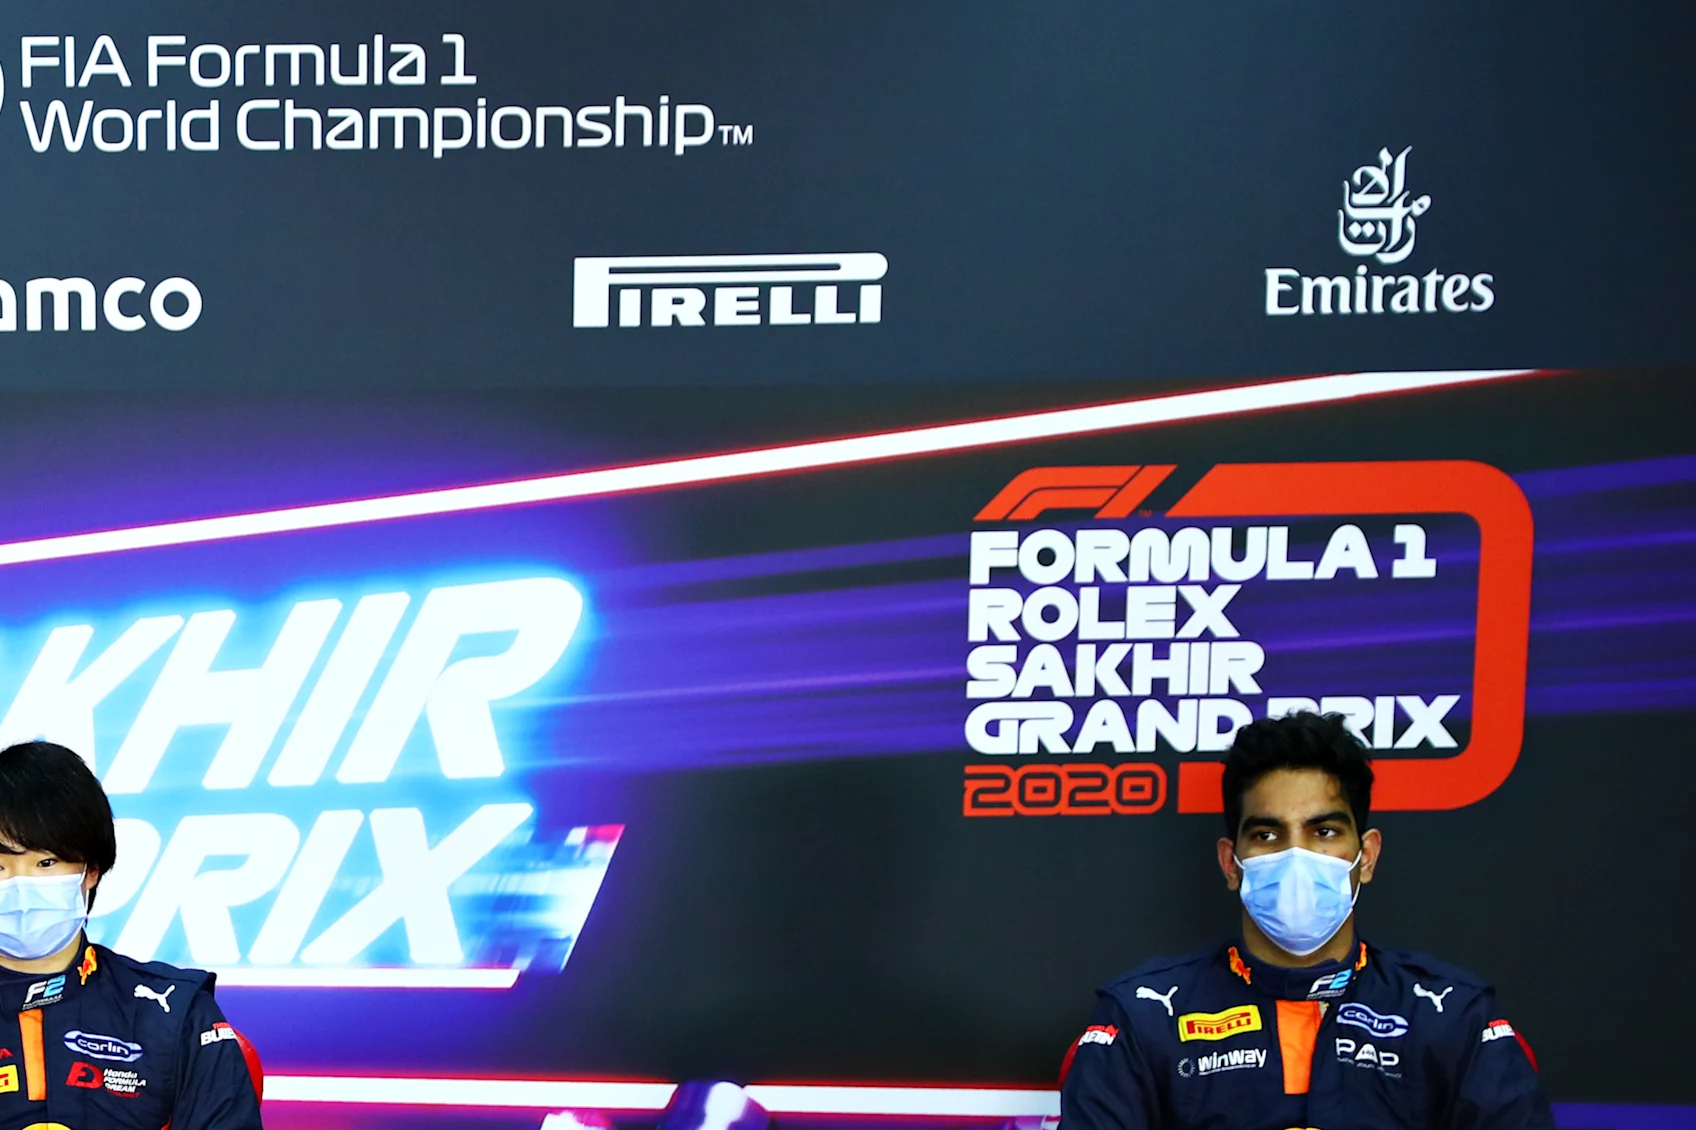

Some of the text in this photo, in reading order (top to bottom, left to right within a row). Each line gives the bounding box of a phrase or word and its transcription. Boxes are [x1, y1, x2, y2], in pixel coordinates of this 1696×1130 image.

[22, 34, 476, 86] FIA Formula 1
[18, 99, 225, 154] World
[234, 96, 716, 158] Championship
[573, 252, 889, 328] PIRELLI
[1264, 264, 1495, 316] Emirates
[969, 523, 1436, 585] FORMULA 1
[967, 584, 1242, 642] ROLEX
[966, 641, 1265, 699] SAKHIR
[964, 698, 1254, 755] GRAND
[963, 762, 1168, 817] 2020
[24, 975, 67, 1003] F2
[1309, 968, 1353, 994] F2
[77, 1038, 130, 1056] carlin
[1186, 1011, 1252, 1035] PIRELLI
[1343, 1009, 1395, 1032] carlin
